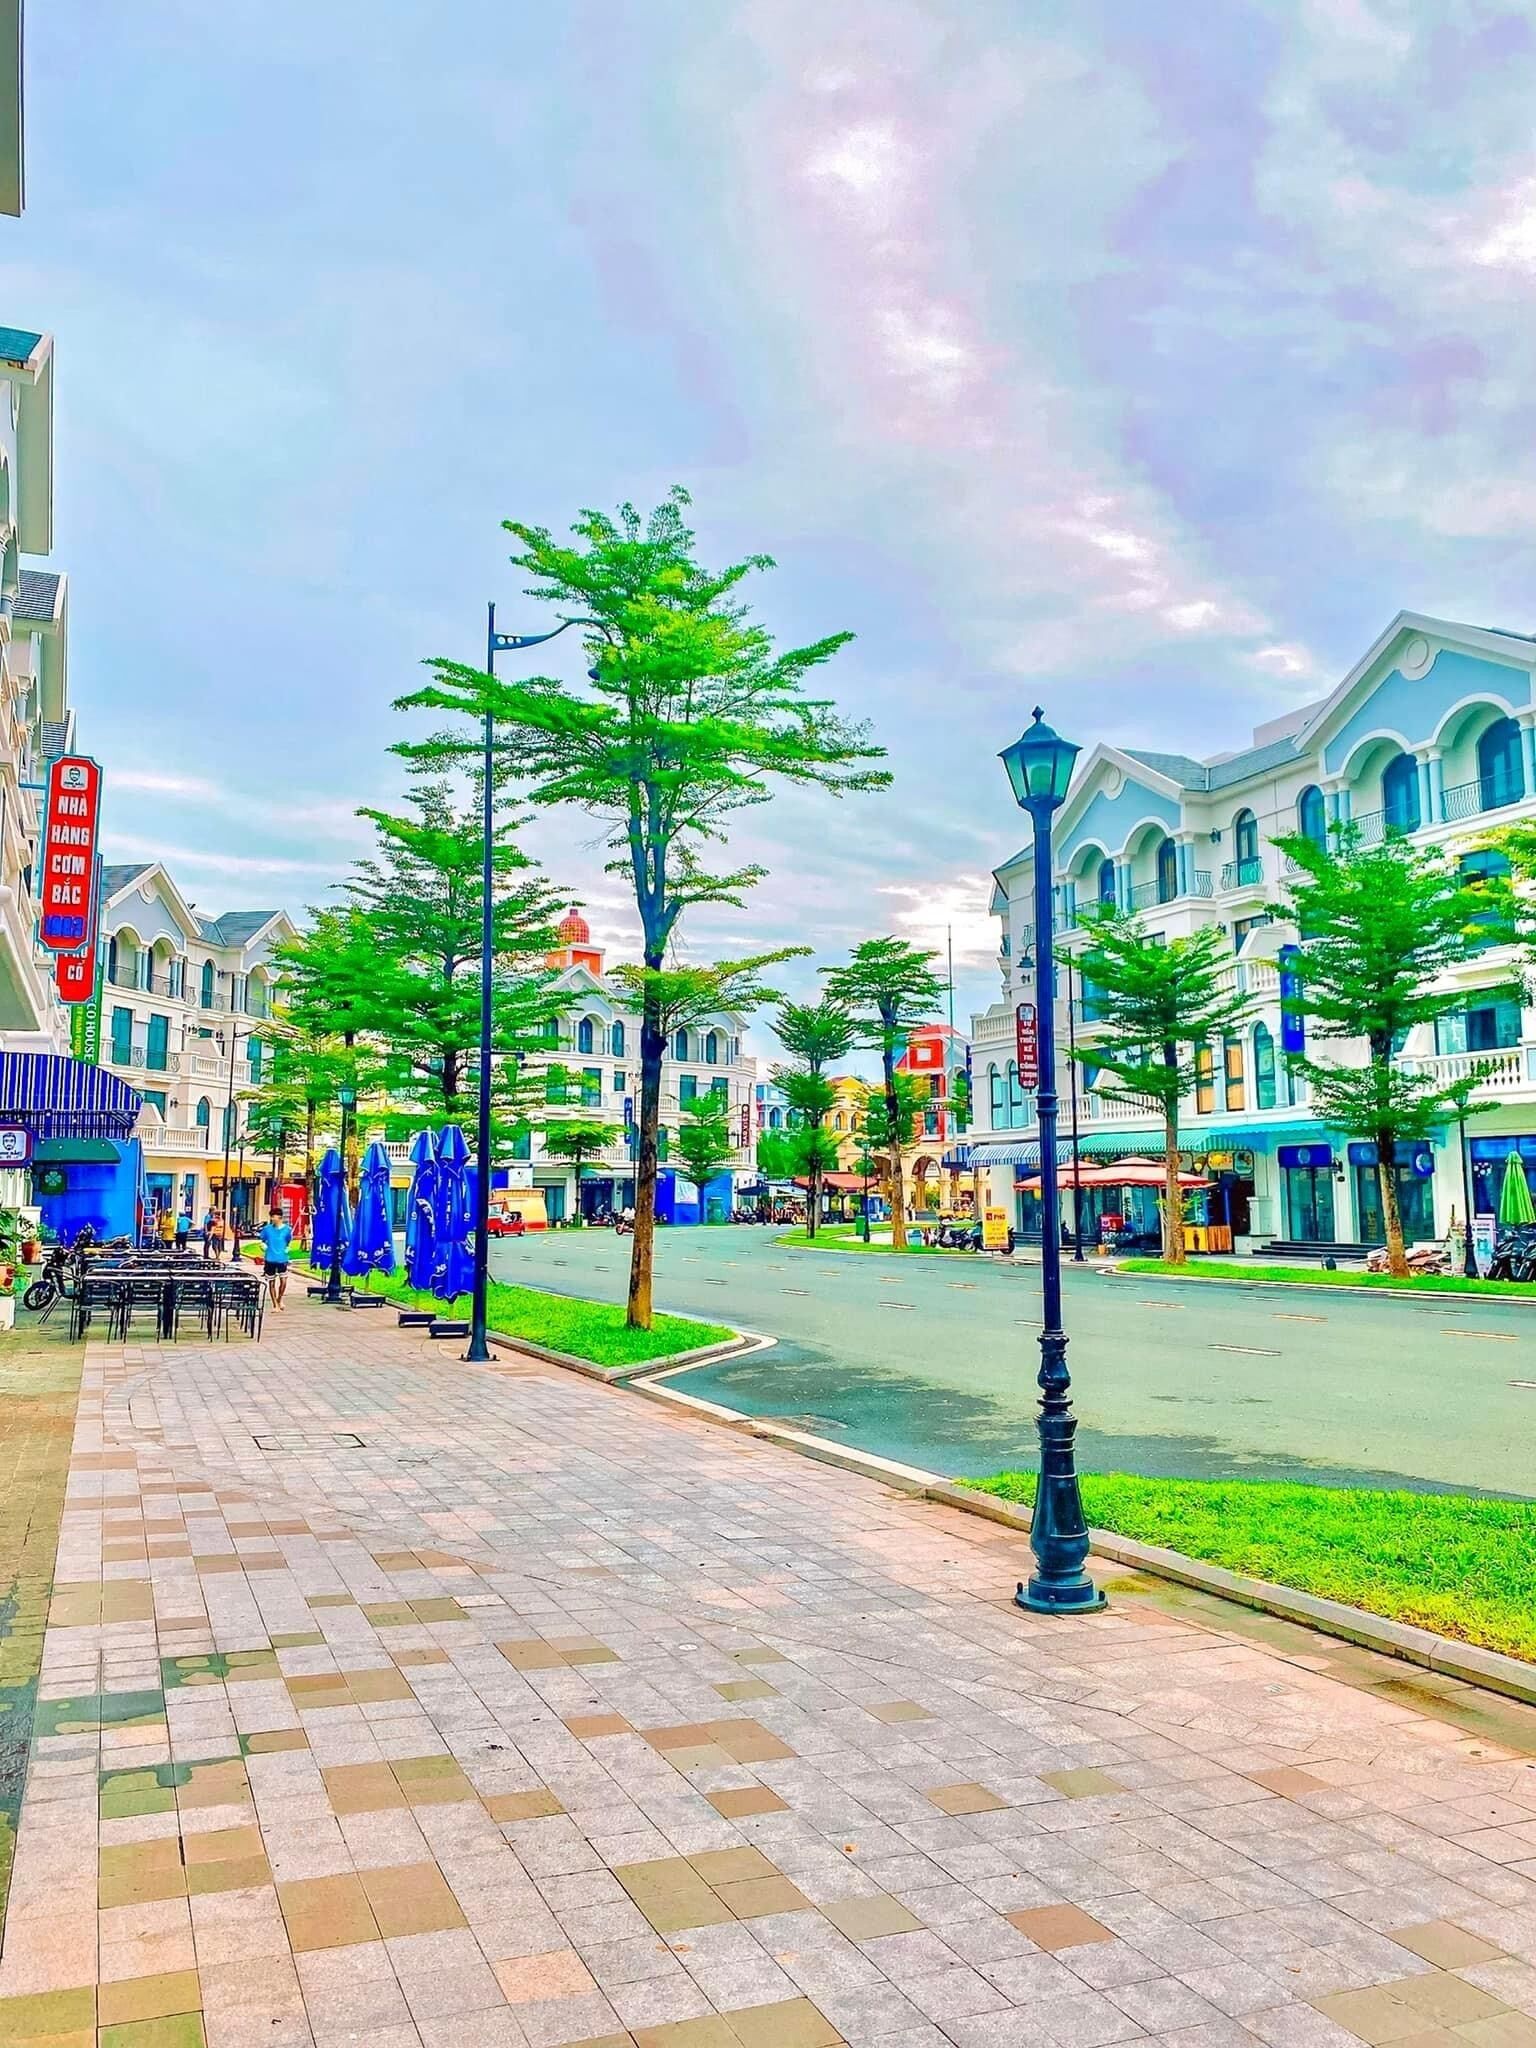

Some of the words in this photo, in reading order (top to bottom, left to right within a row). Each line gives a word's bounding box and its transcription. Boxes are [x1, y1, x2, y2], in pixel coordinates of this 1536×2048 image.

[57, 793, 88, 816] NHÀ
[51, 821, 90, 846] HÀNG
[51, 854, 85, 875] CƠM
[51, 877, 81, 904] BẮC
[84, 1021, 97, 1061] HOUSE
